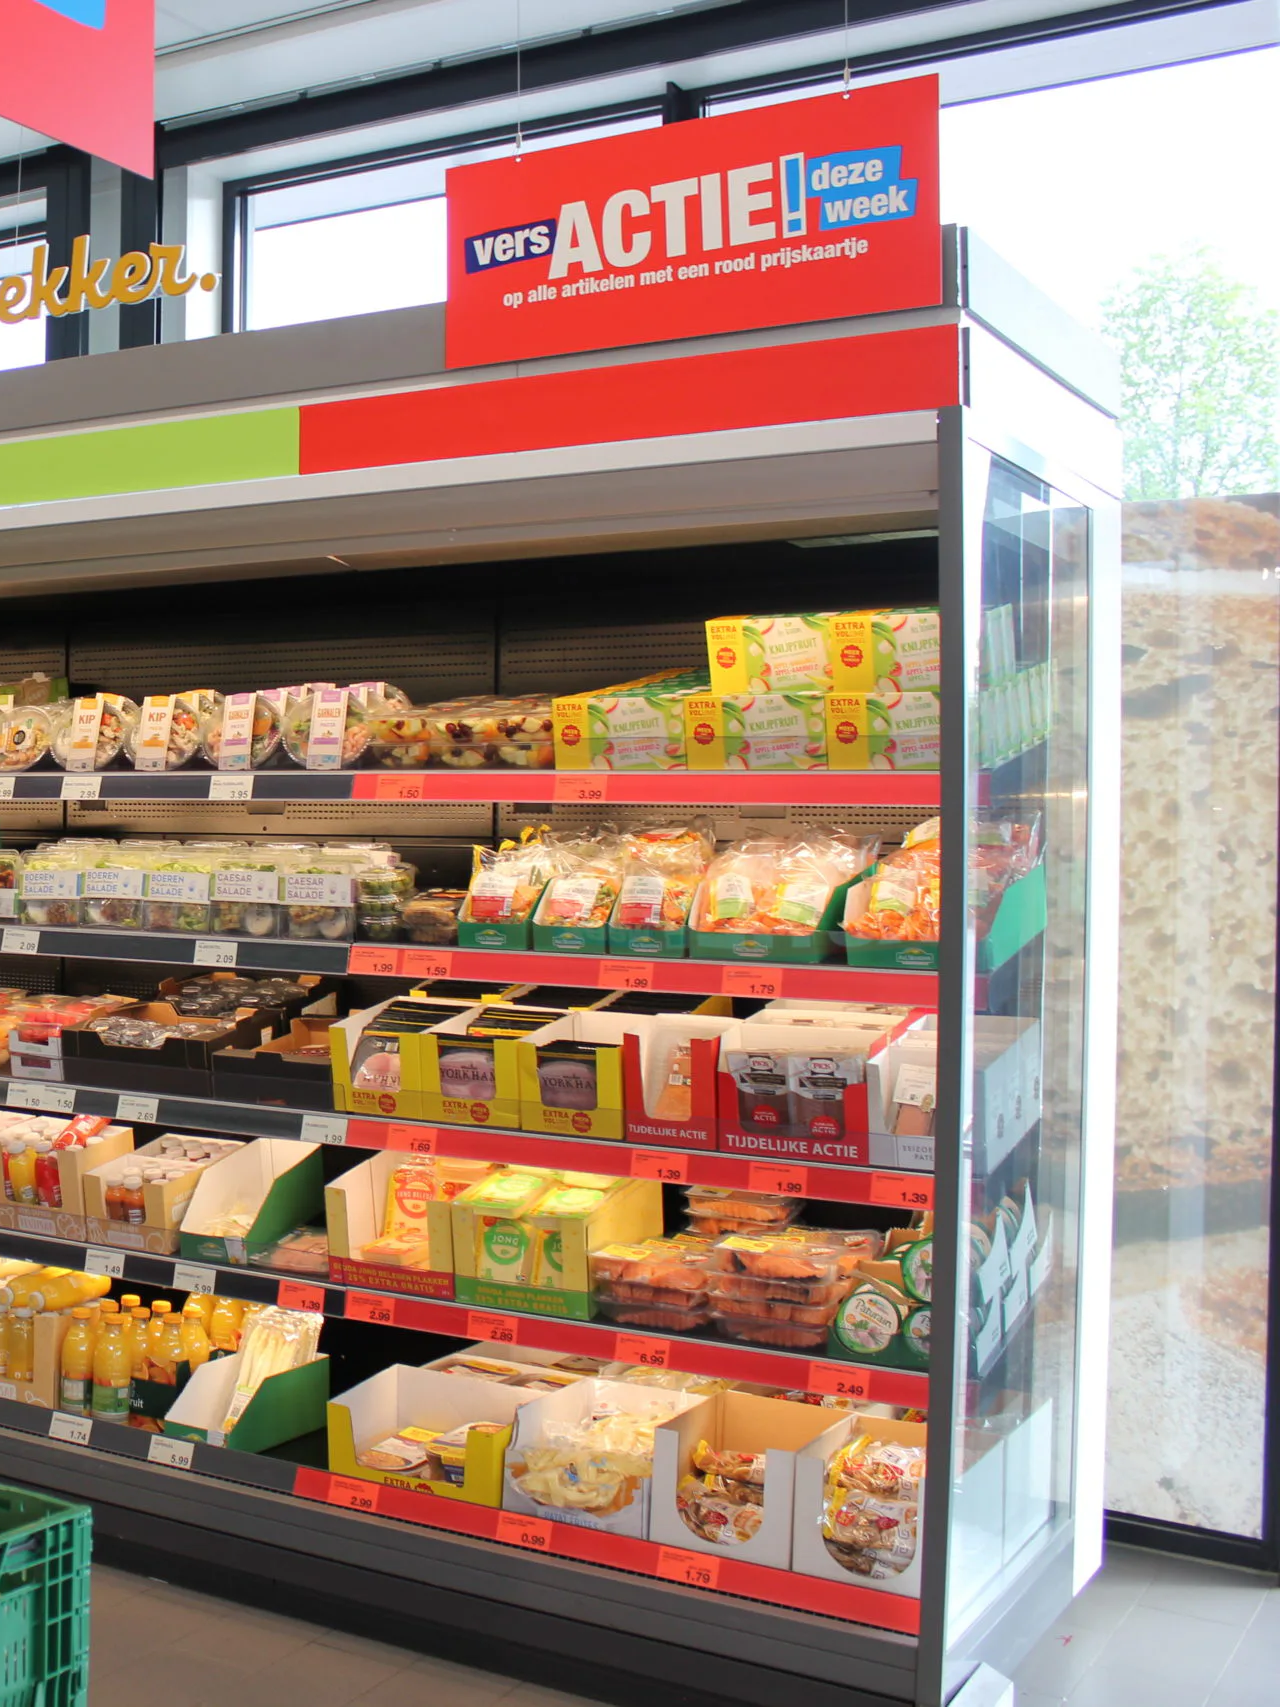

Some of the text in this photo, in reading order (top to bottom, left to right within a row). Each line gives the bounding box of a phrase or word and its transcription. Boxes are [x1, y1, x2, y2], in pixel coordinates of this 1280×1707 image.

[810, 156, 884, 192] deze
[823, 186, 910, 224] week
[471, 152, 808, 280] vers ACTIE!
[502, 236, 869, 309] op alle artikelen met een rood prijskaartje
[710, 625, 737, 634] EXTRA
[834, 622, 865, 631] EXTRA
[556, 703, 582, 711] EXTRA
[688, 702, 716, 710] EXTRA
[830, 698, 860, 706] EXTRA
[78, 713, 95, 725] KIP
[147, 711, 167, 722] KIP
[895, 716, 940, 731] KNIJPFRU
[79, 790, 96, 799] 2.95
[230, 790, 248, 799] 3.95
[398, 789, 419, 798] 1.50
[578, 789, 602, 799] 3.99
[24, 873, 55, 882] BOEREN
[87, 871, 119, 880] BOEREN
[151, 874, 184, 883] BOEREN
[217, 873, 252, 883] CAESAR
[287, 876, 324, 886] CAESAR
[24, 885, 54, 894] SALADE
[86, 883, 118, 892] SALADE
[150, 887, 183, 896] SALADE
[216, 886, 252, 896] SALADE
[287, 889, 324, 899] SALADE
[20, 942, 36, 950] 2.09
[216, 954, 234, 963] 2.09
[373, 963, 393, 973] 1.99
[426, 966, 447, 976] 1.59
[625, 978, 648, 988] 1.99
[749, 984, 775, 995] 1.79
[441, 1067, 470, 1081] YORK
[575, 1078, 593, 1089] HA
[352, 1091, 376, 1101] EXTRA
[25, 1098, 41, 1107] 1.50
[57, 1099, 73, 1109] 1.50
[442, 1100, 468, 1110] EXTRA
[137, 1111, 154, 1121] 2.69
[543, 1109, 570, 1119] EXTRA
[628, 1123, 708, 1141] TIJDELIJKE ACTIE
[324, 1133, 343, 1144] 1.99
[726, 1134, 859, 1159] TIJDELIJKE ACTIE
[902, 1144, 935, 1154] SEIZOE
[657, 1169, 680, 1180] 1.39
[777, 1182, 802, 1193] 1.99
[901, 1192, 928, 1204] 1.39
[492, 1233, 519, 1246] JONG
[104, 1265, 120, 1274] 1.49
[194, 1284, 211, 1294] 5.99
[368, 1277, 398, 1288] EXTRA
[401, 1283, 434, 1293] GRATIS
[301, 1300, 320, 1310] 1.39
[370, 1311, 390, 1321] 2.99
[491, 1330, 513, 1342] 2.89
[640, 1353, 664, 1365] 6.99
[836, 1382, 864, 1396] 2.49
[129, 1398, 144, 1408] ruit
[70, 1430, 87, 1442] 1.74
[170, 1455, 188, 1466] 5.99
[384, 1476, 411, 1489] EXTRA
[350, 1496, 372, 1508] 2.99
[521, 1534, 545, 1546] 0.99
[685, 1571, 710, 1584] 1.79
